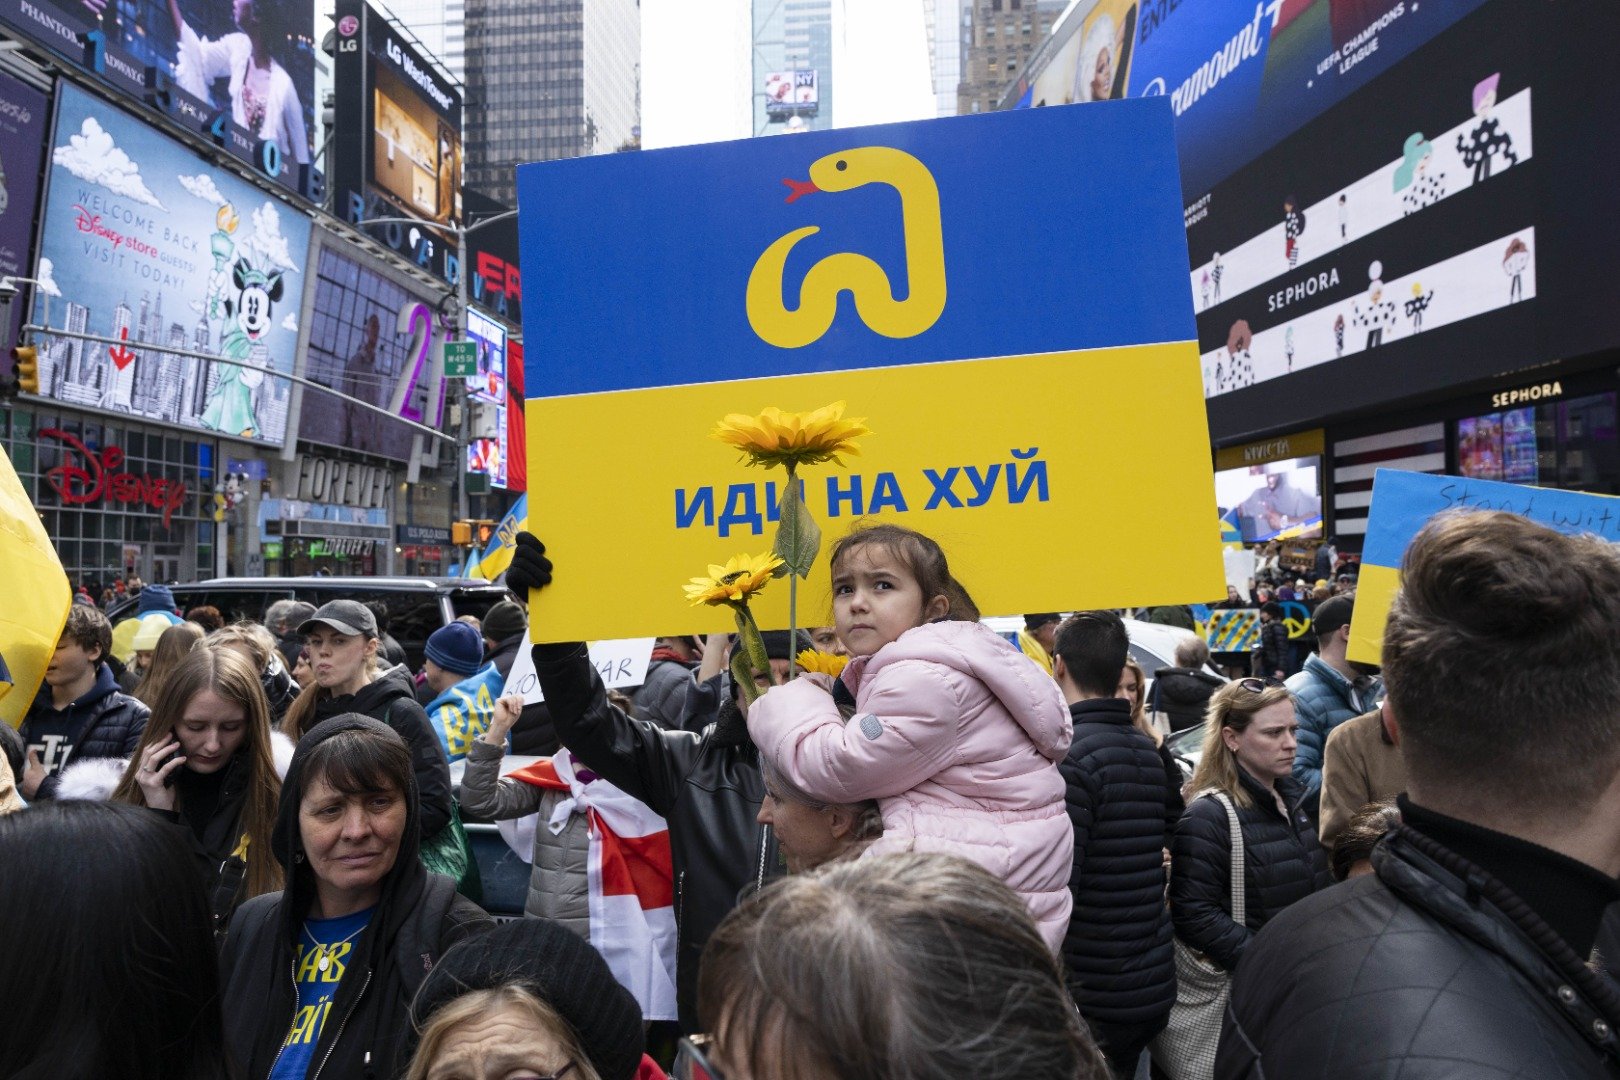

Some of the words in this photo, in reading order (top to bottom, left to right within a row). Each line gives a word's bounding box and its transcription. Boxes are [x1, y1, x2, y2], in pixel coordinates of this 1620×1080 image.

[339, 40, 357, 52] LG
[387, 38, 402, 65] LG
[1317, 50, 1341, 75] UEFA
[1342, 1, 1405, 56] CHAMPIONS
[1340, 37, 1379, 74] LEAGUE
[72, 204, 124, 250] Disney
[125, 236, 158, 259] store
[78, 188, 155, 235] WELCOME
[163, 226, 199, 254] BACK
[83, 240, 125, 269] VISIT
[134, 259, 186, 292] TODAY!
[1267, 267, 1341, 313] SEPHORA
[1492, 381, 1563, 408] SEPHORA
[38, 428, 188, 530] Disney
[296, 454, 392, 509] FOREVER
[826, 472, 909, 518] НА
[922, 447, 1050, 511] ХУЙ
[323, 538, 362, 556] FOREVER
[595, 656, 632, 683] AR
